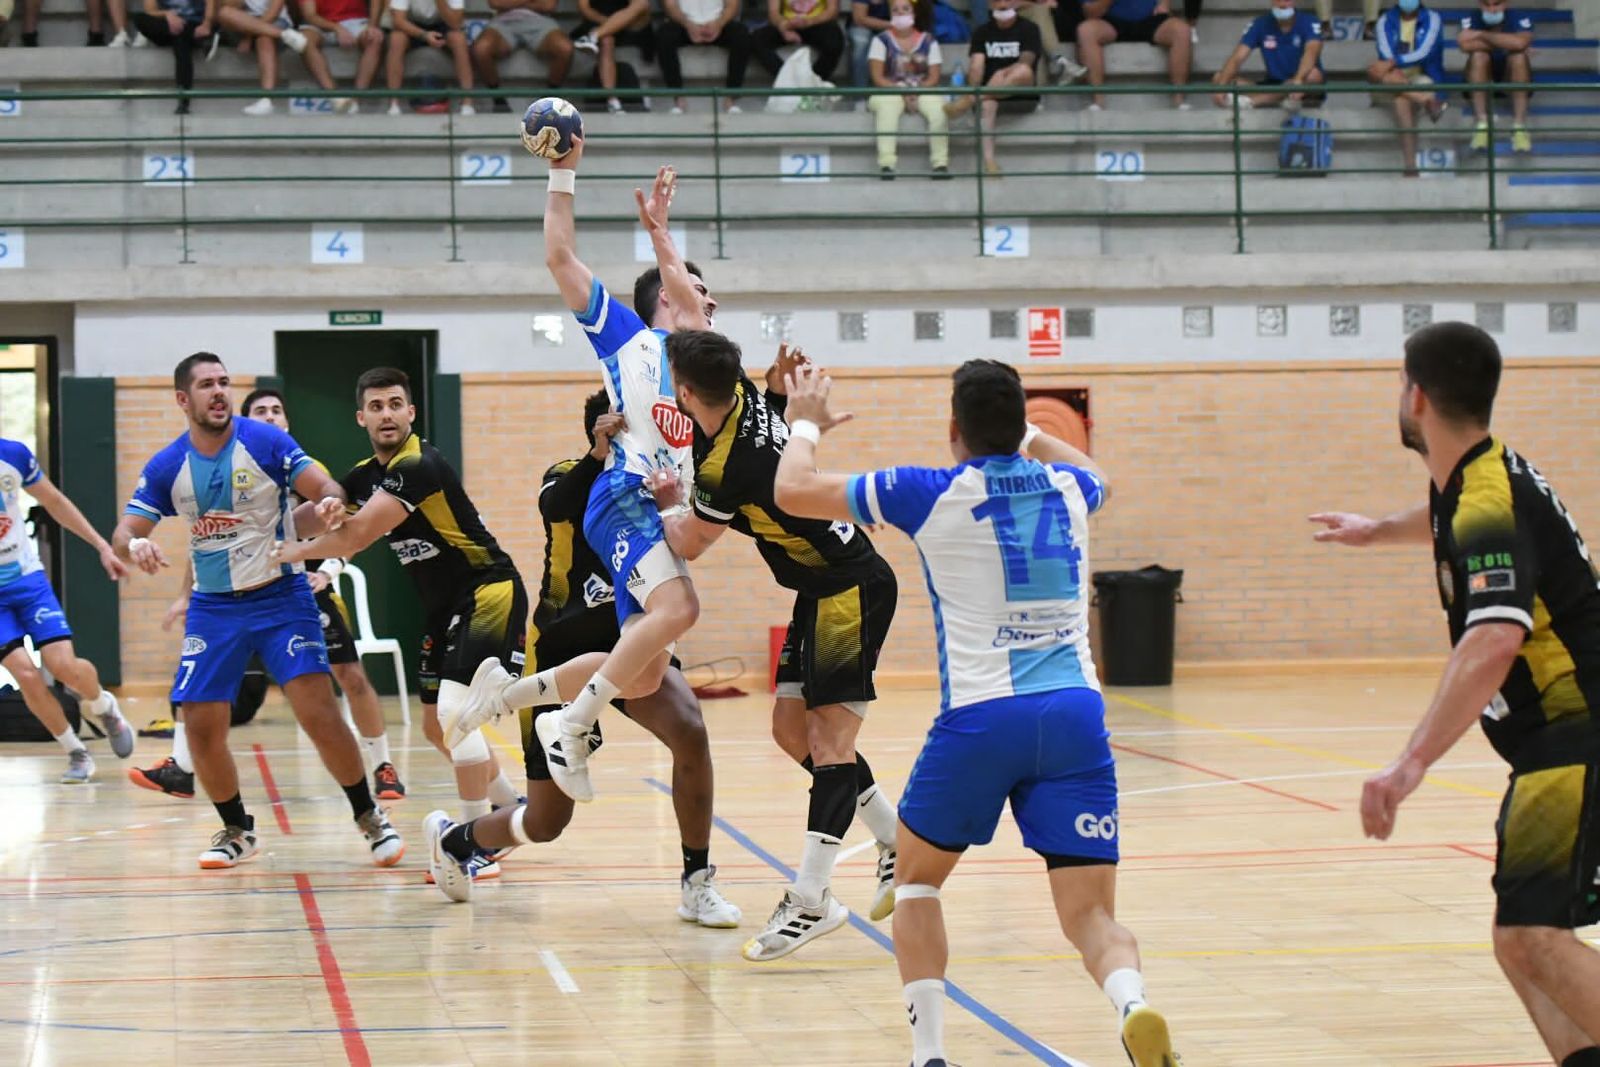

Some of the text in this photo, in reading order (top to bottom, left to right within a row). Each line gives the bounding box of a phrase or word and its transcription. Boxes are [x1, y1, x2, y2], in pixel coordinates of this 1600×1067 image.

[150, 155, 188, 179] 23
[467, 154, 506, 178] 22
[792, 153, 821, 177] 21
[1101, 151, 1140, 175] 20
[326, 229, 349, 258] 4
[995, 224, 1014, 252] 2
[971, 491, 1082, 586] 14
[179, 660, 196, 691] 7
